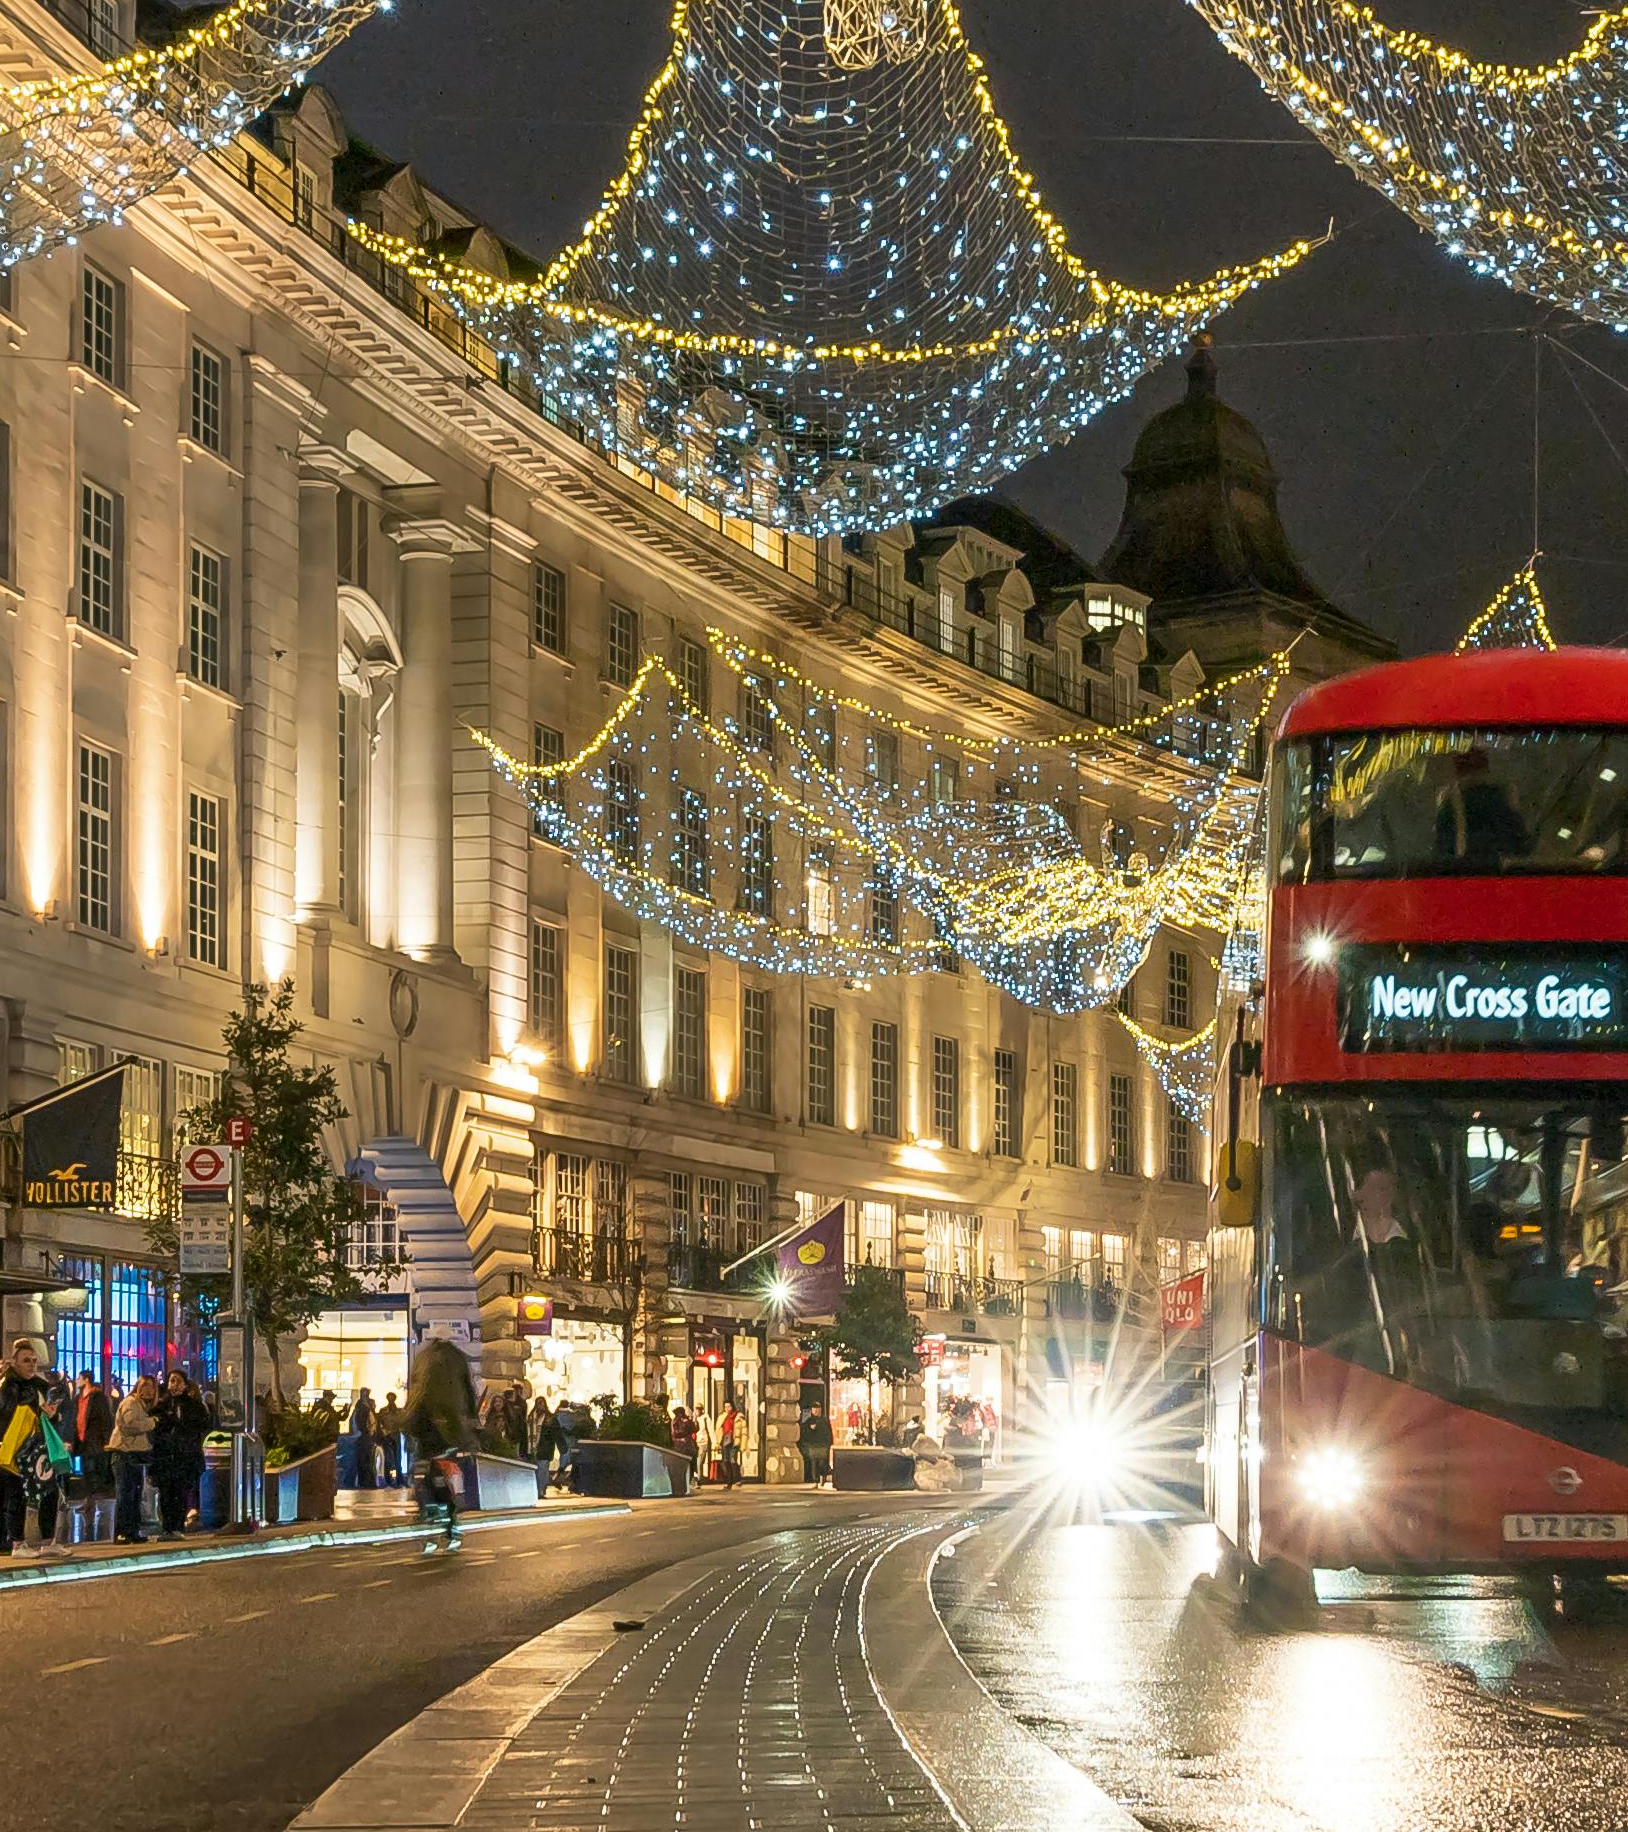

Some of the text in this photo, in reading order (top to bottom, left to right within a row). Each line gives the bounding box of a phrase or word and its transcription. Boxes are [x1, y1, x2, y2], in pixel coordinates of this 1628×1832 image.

[1372, 975, 1437, 1019] New
[1445, 974, 1528, 1019] Cross
[1536, 974, 1611, 1019] Gate
[231, 1121, 244, 1141] E
[1166, 1290, 1194, 1305] UNI
[1165, 1307, 1194, 1323] QLO
